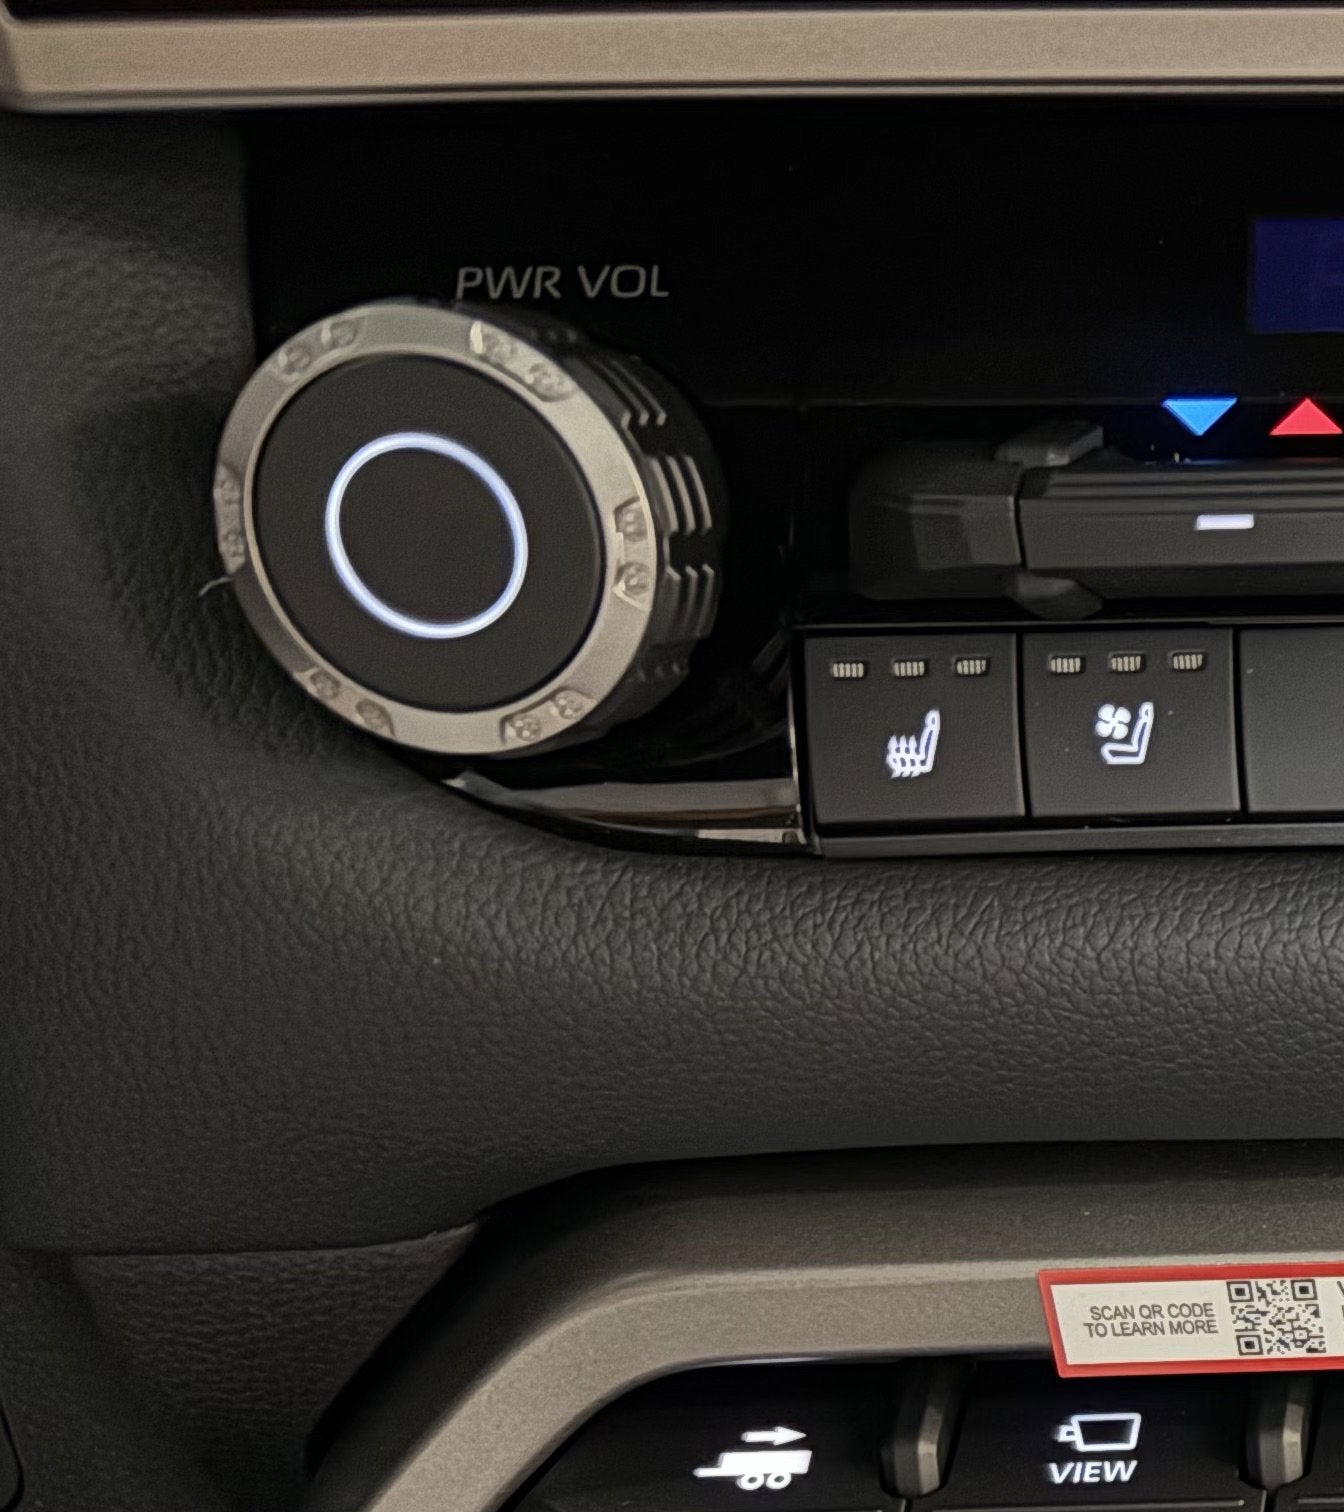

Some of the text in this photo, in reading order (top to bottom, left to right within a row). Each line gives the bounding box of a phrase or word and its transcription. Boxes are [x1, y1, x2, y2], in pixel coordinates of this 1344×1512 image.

[456, 264, 670, 299] PWR VOL
[1089, 1302, 1215, 1321] SCAN QR CODE
[1083, 1319, 1219, 1338] TO LEARN MORE
[1048, 1459, 1140, 1484] VIEW
